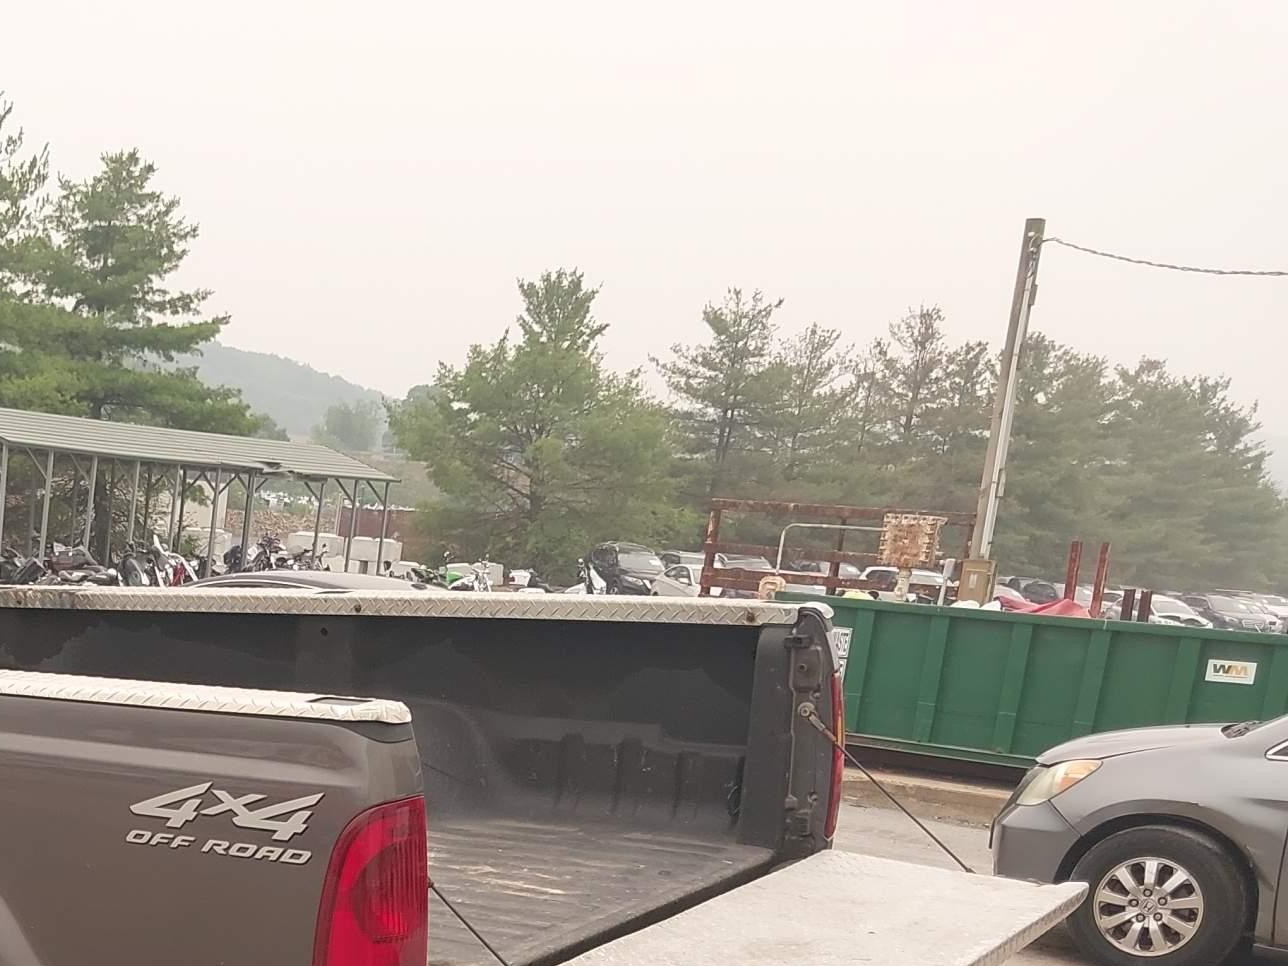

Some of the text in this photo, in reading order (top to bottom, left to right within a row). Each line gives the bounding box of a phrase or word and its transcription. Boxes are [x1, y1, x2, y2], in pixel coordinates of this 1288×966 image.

[1213, 663, 1249, 676] WM
[125, 829, 312, 865] OFF ROAD
